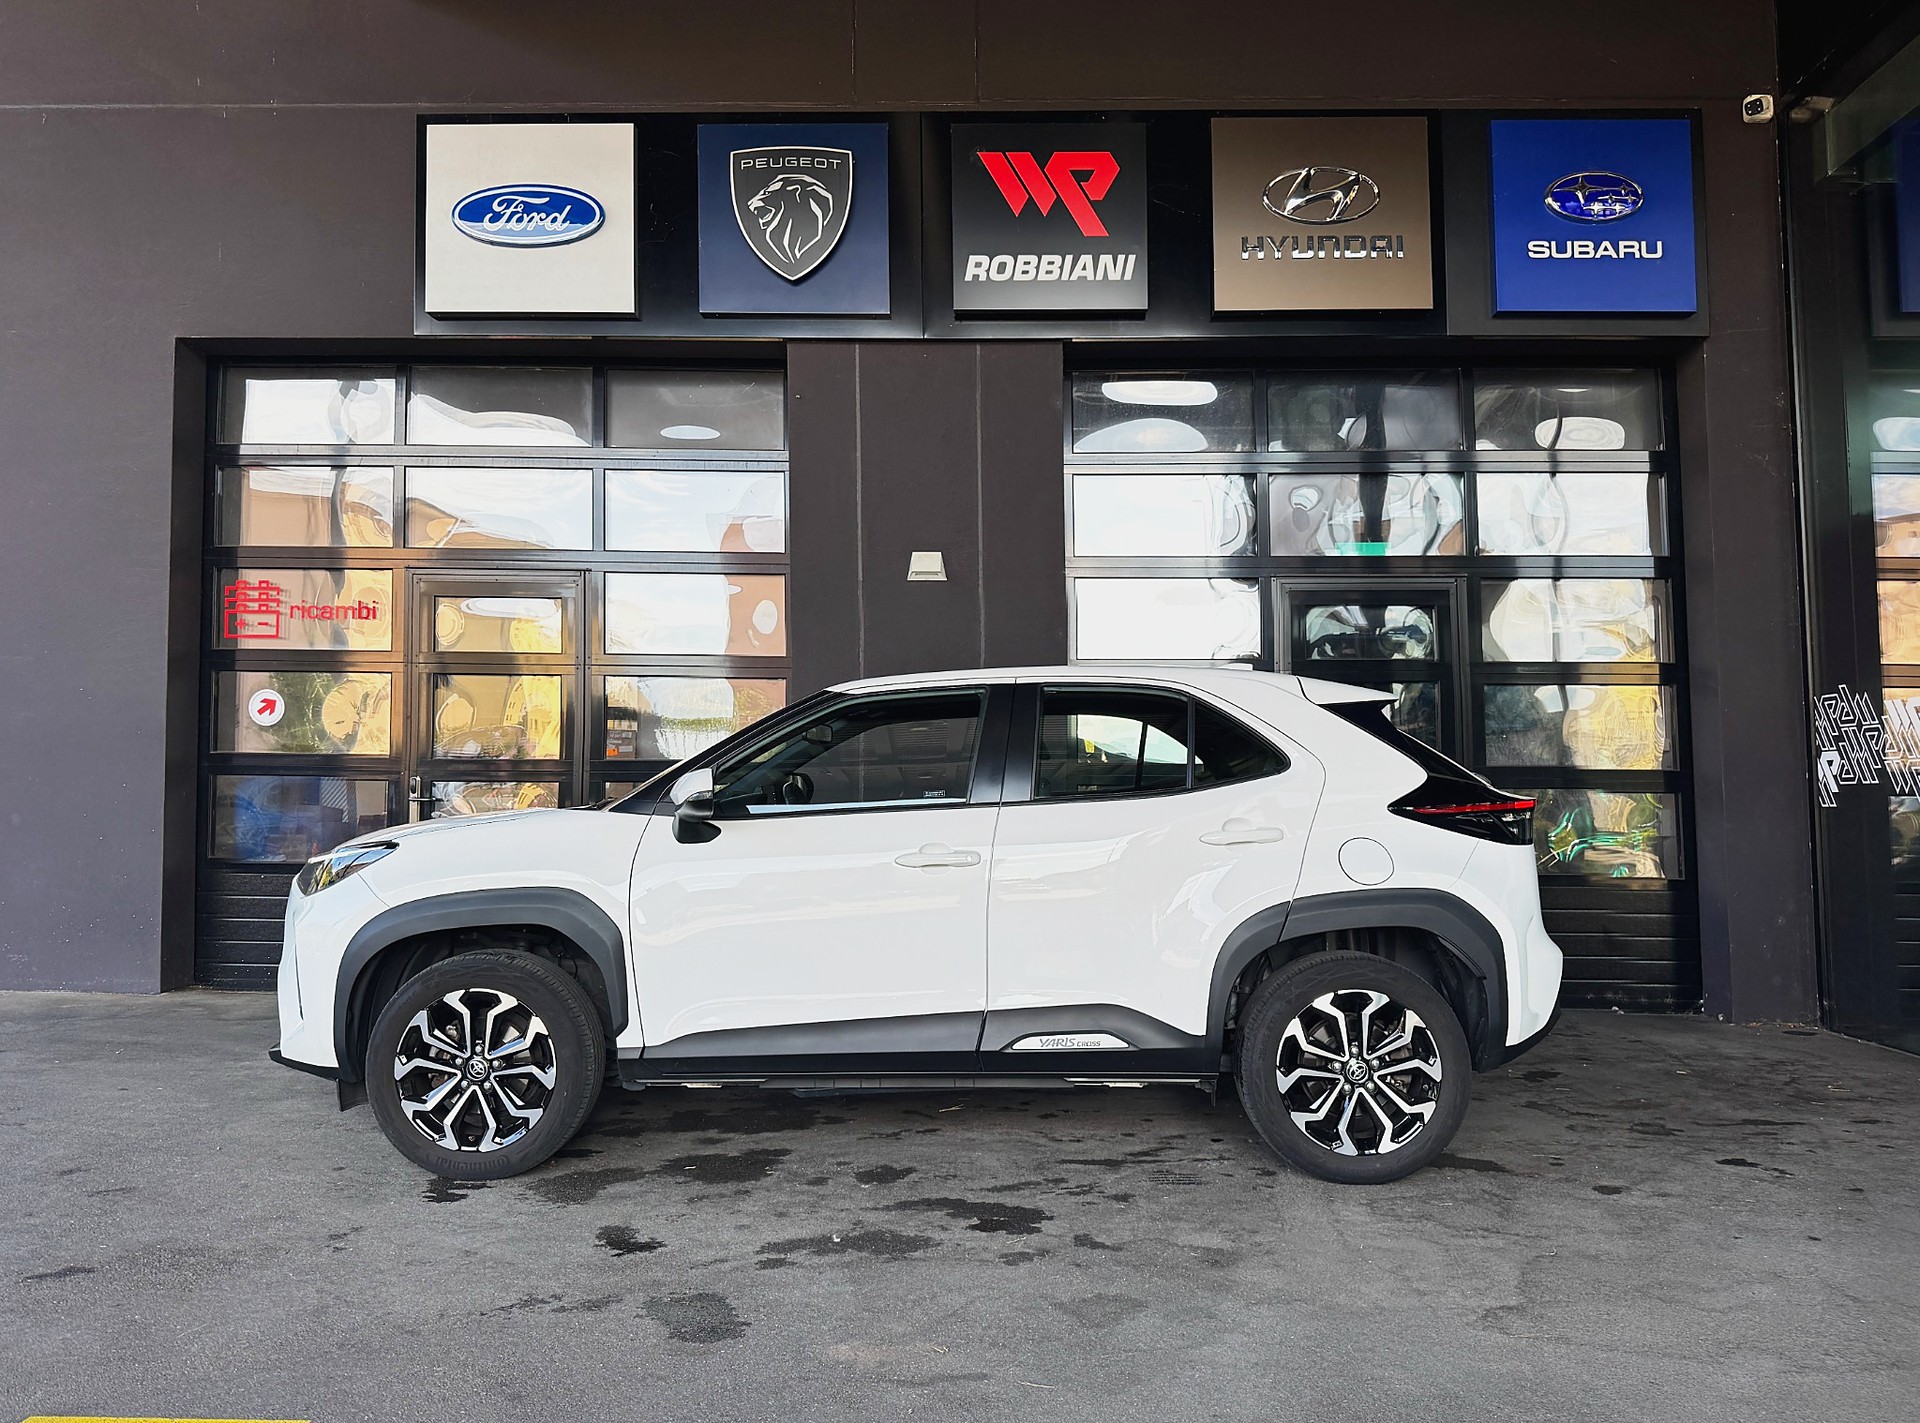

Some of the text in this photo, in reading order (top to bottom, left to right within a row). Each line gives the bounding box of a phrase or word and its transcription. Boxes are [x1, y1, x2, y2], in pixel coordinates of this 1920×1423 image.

[740, 157, 843, 171] PEUGEOT
[483, 195, 571, 233] Ford
[1240, 235, 1406, 261] HYUNDAI
[1527, 239, 1664, 260] SUBARU
[964, 254, 1137, 283] ROBBIANI
[289, 600, 378, 620] ricambi
[1039, 1037, 1101, 1048] YARIS CROSS
